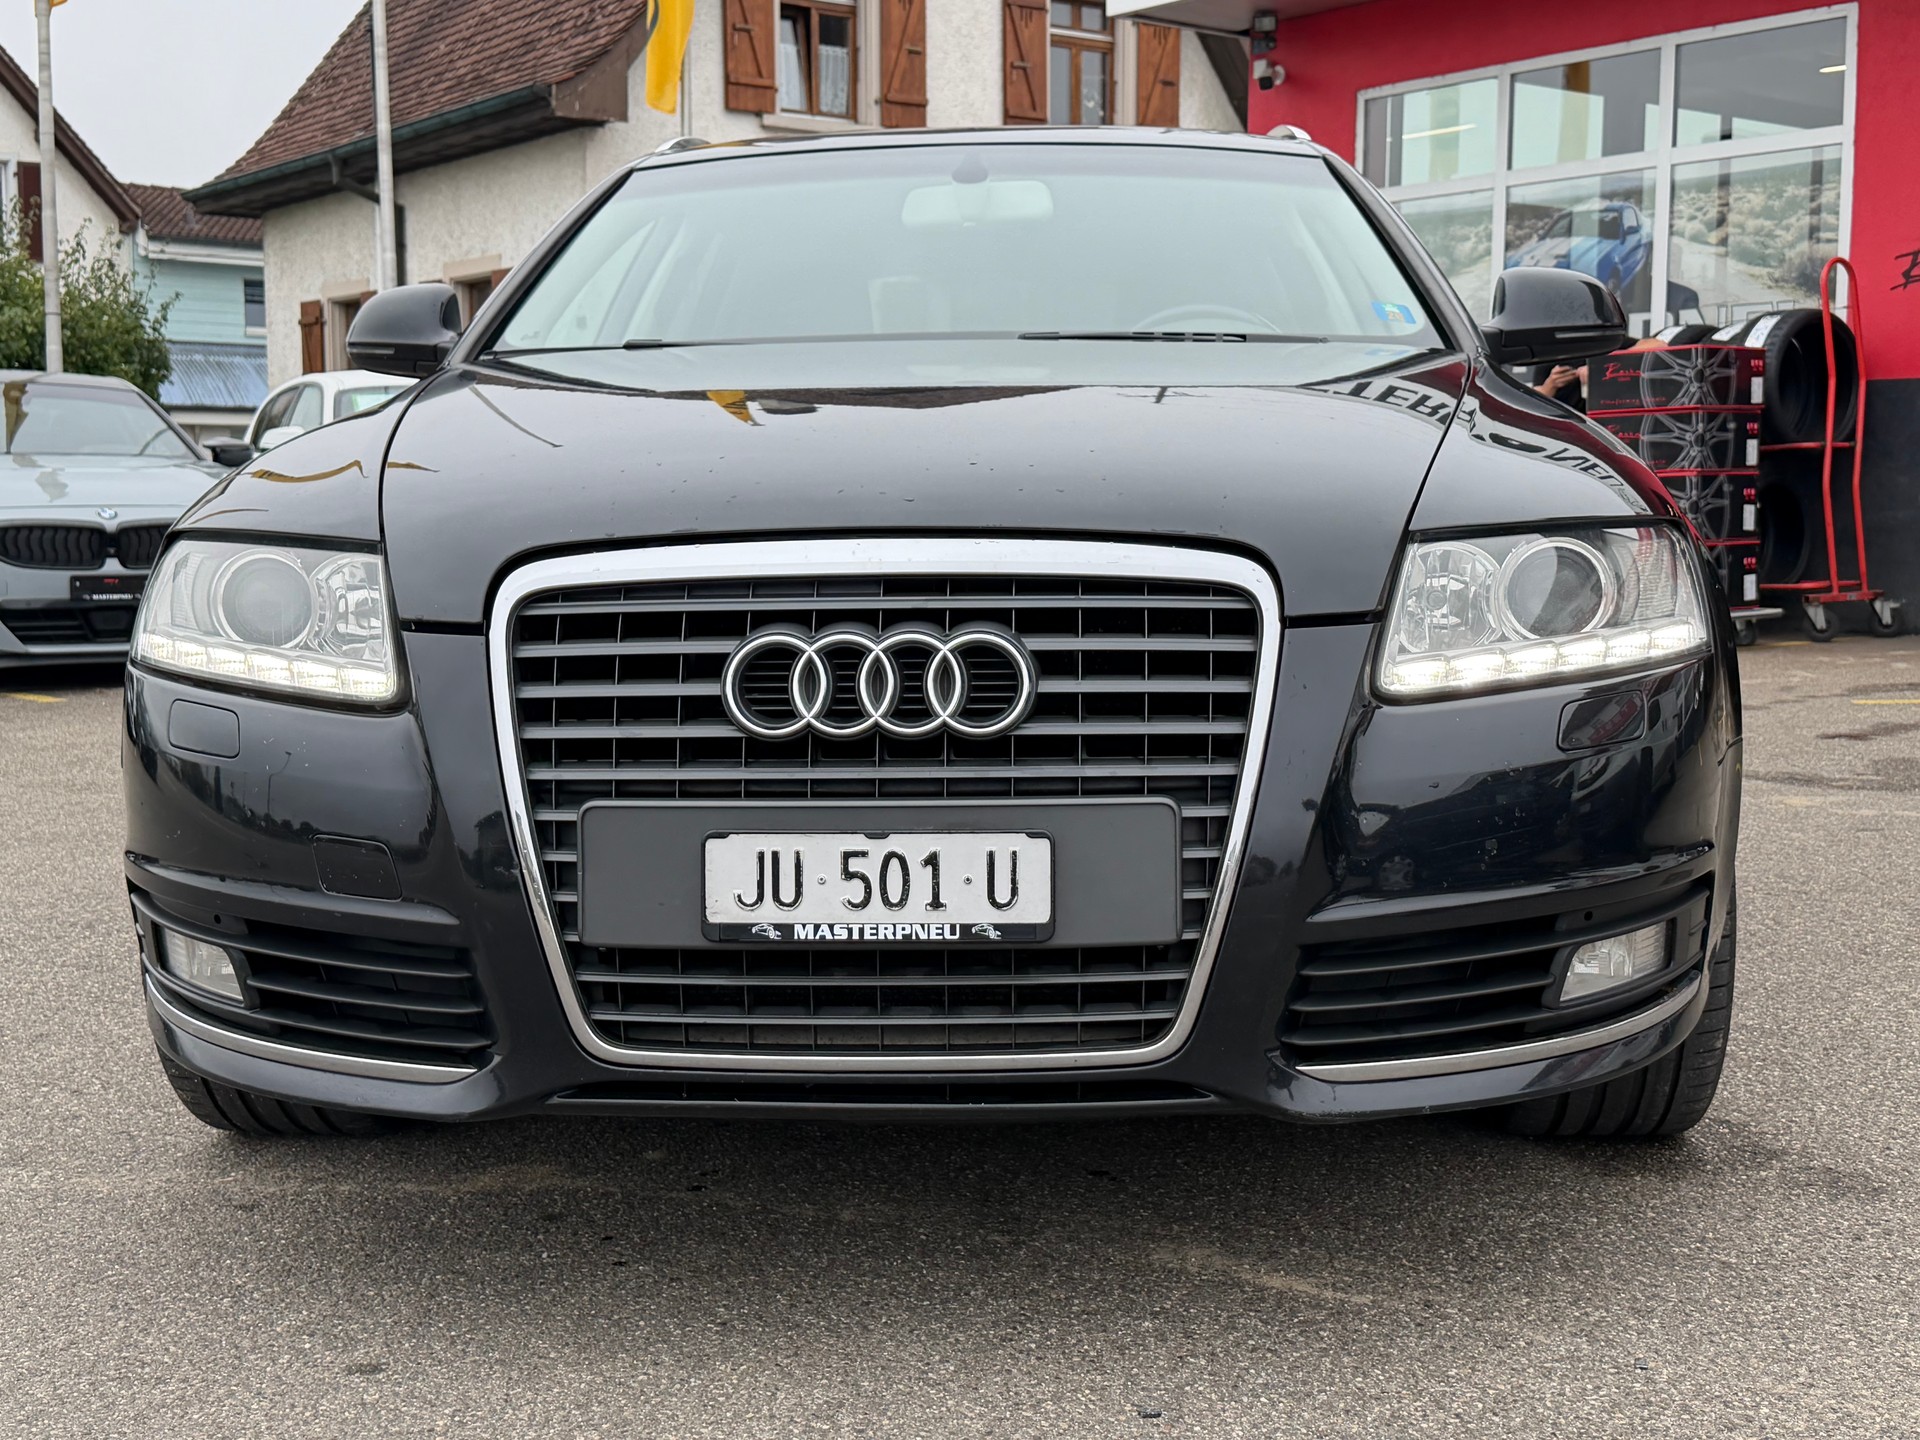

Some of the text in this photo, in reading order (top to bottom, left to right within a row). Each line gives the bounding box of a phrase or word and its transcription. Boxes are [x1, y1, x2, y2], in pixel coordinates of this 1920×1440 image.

[733, 848, 1019, 911] JU 501 U
[793, 923, 960, 940] MASTERPNEU
